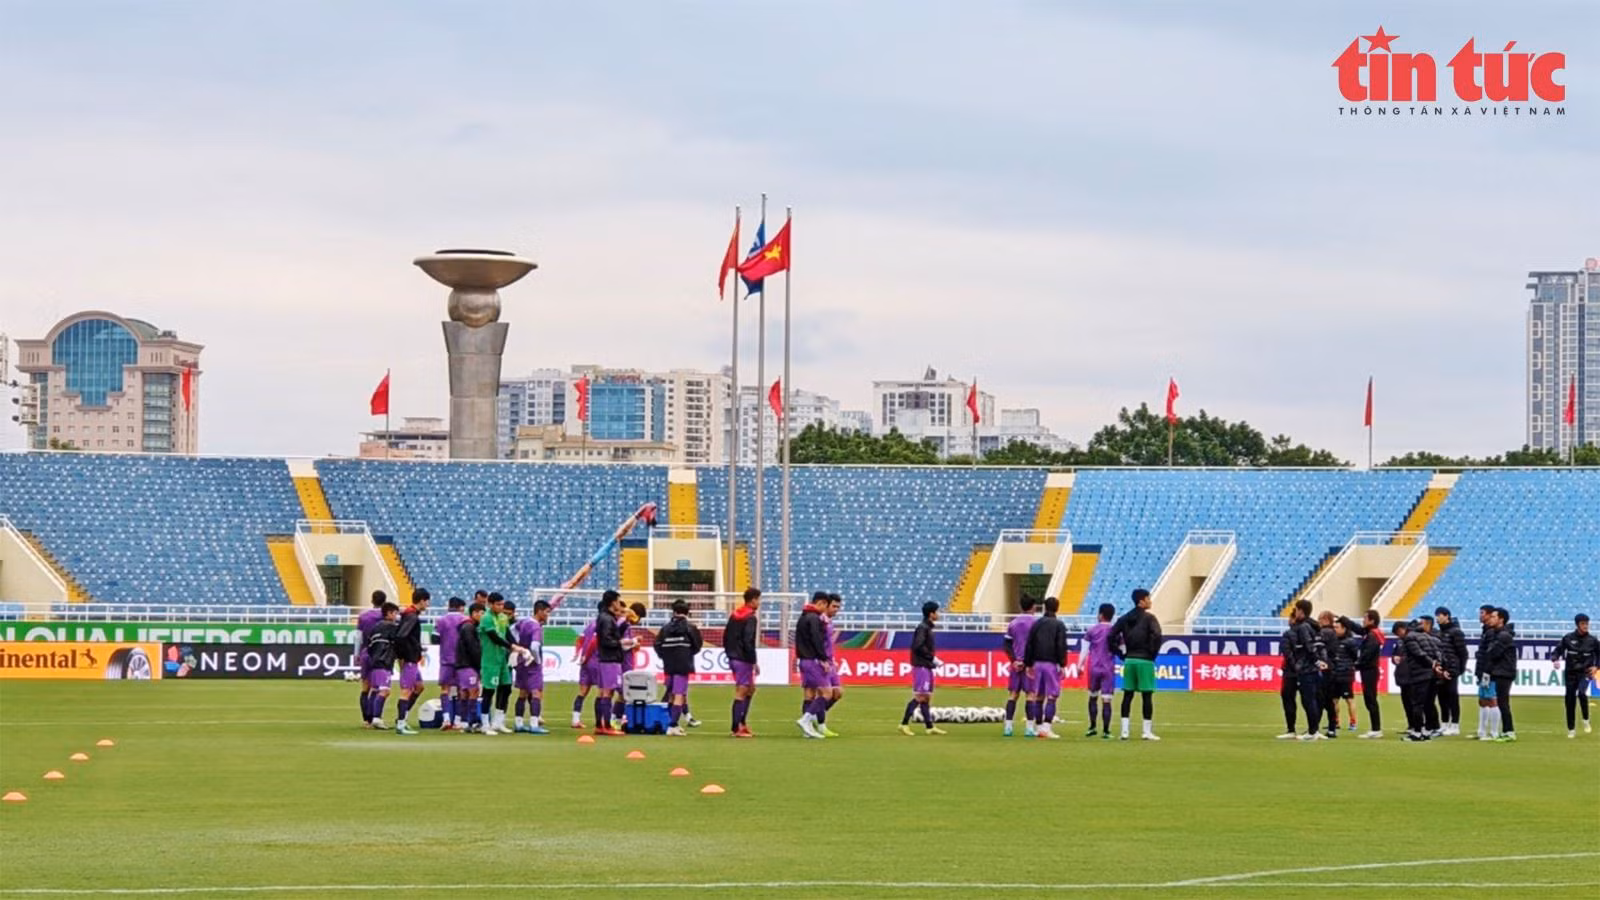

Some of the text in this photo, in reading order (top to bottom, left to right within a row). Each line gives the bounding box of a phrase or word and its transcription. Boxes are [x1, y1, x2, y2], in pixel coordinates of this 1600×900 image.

[201, 652, 287, 671] NEOM
[856, 658, 895, 677] PHÊ
[1195, 664, 1274, 682] 卡尔美体育
